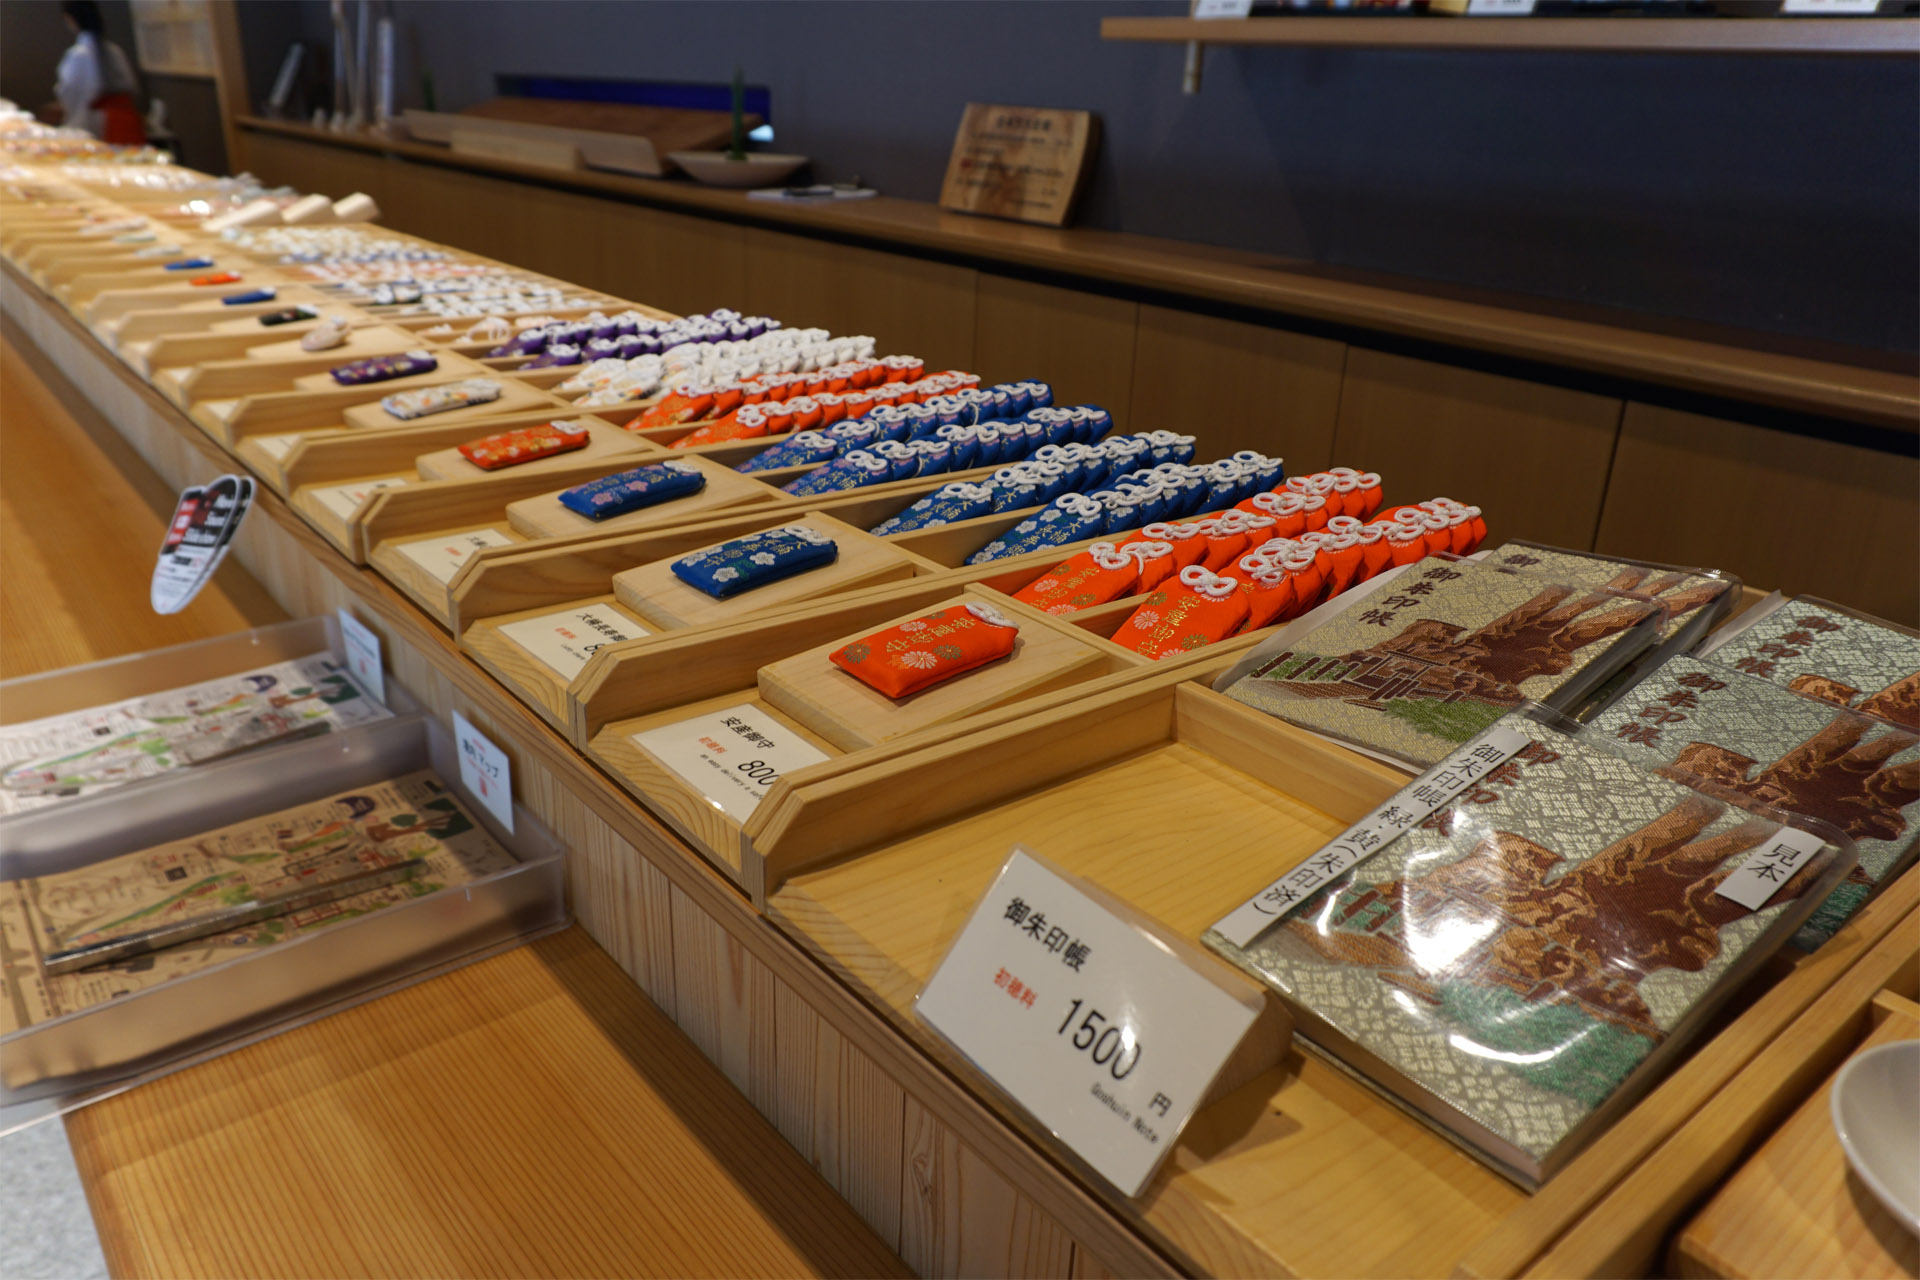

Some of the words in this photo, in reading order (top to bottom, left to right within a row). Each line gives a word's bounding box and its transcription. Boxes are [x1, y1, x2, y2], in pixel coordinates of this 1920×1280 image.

[1358, 566, 1462, 627] 御朱印帳
[1735, 615, 1841, 678] 御朱印帳
[720, 716, 775, 748] 安産御守
[1616, 672, 1727, 748] 御朱印帳
[1413, 743, 1505, 808] 御朱印帳
[1747, 844, 1801, 882] 見本
[1003, 896, 1092, 973] 御朱印帳
[1057, 998, 1142, 1081] 1500
[1149, 1092, 1172, 1117] 円
